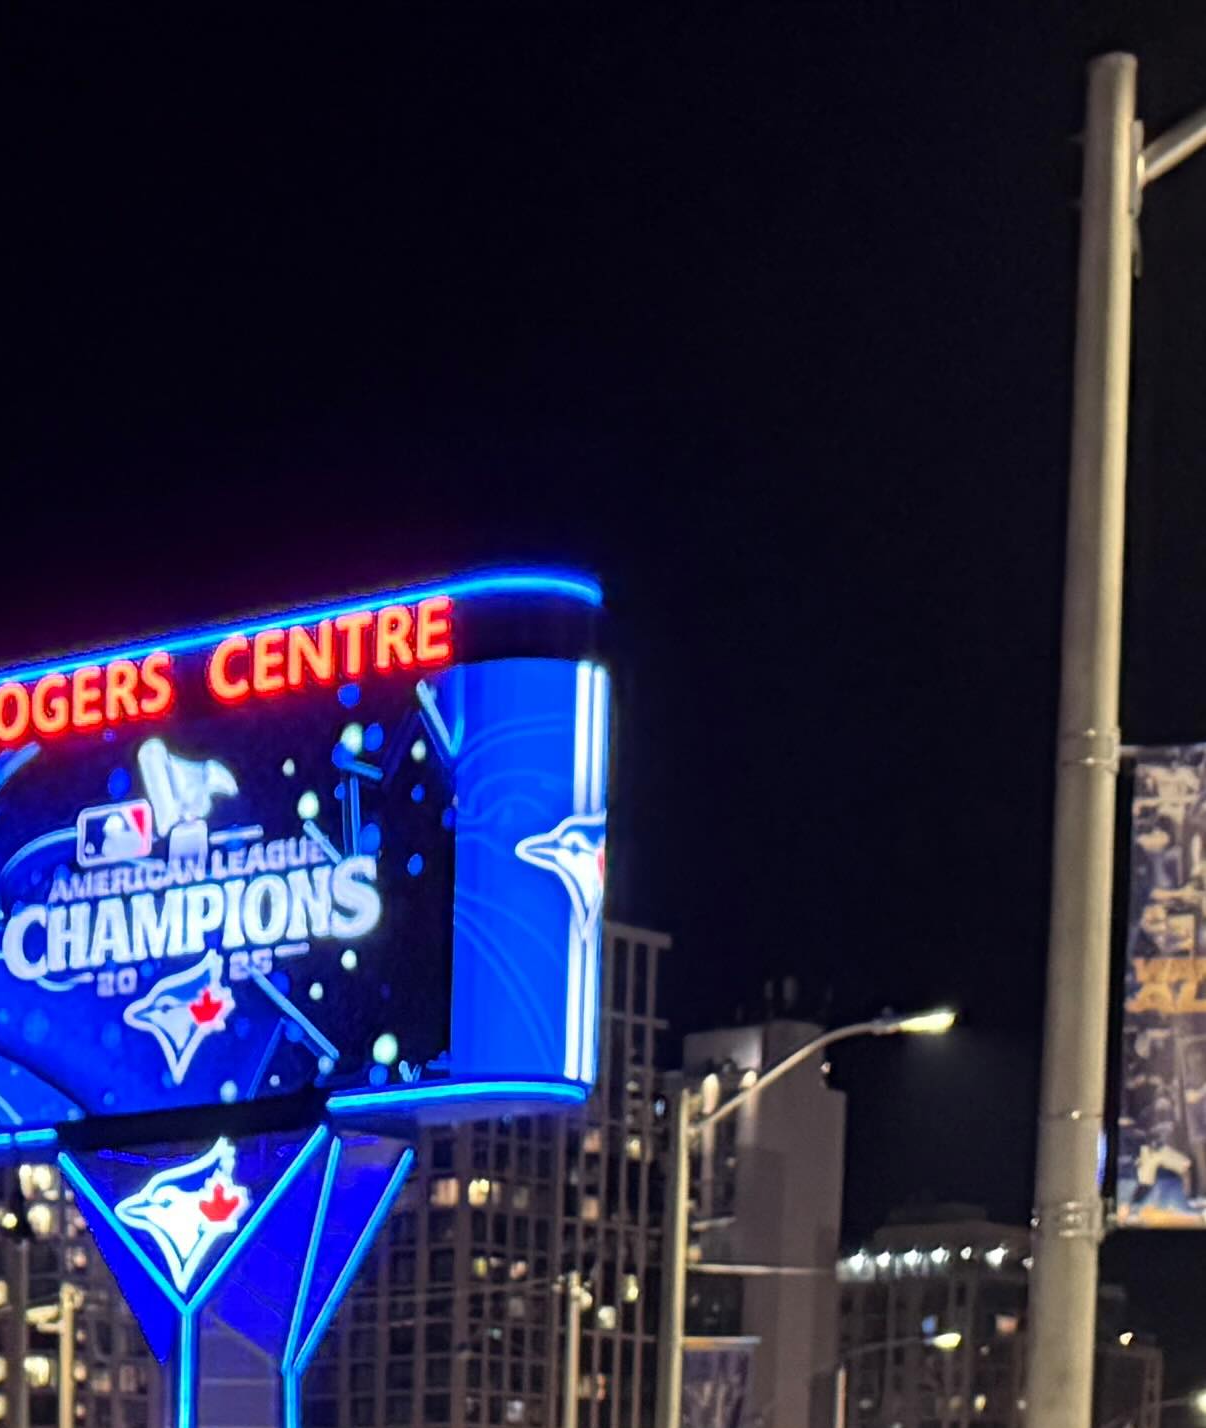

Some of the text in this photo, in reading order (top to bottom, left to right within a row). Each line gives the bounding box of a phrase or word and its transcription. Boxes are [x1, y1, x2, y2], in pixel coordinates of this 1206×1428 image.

[206, 594, 454, 704] CENTRE
[46, 835, 328, 903] AMERICAN LEAGUE
[2, 855, 381, 980] CHAMPIONS
[96, 946, 274, 998] 20 25
